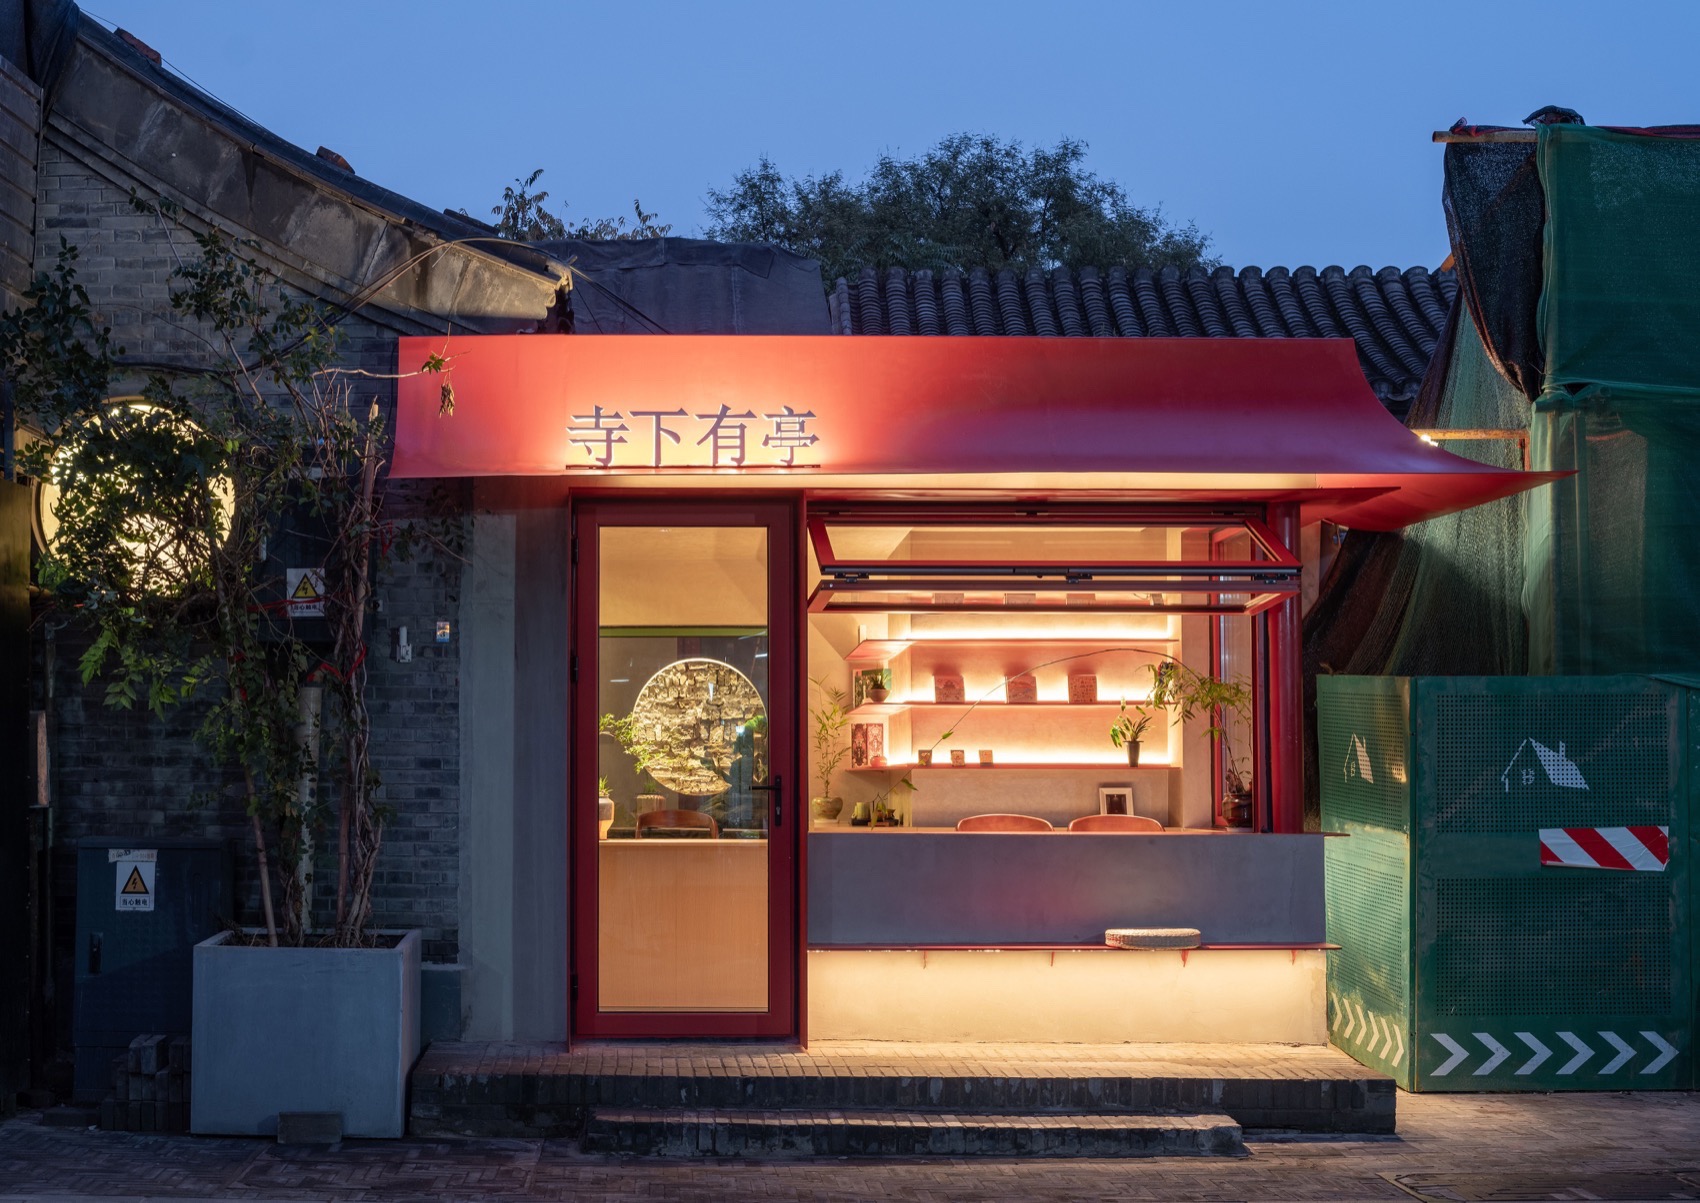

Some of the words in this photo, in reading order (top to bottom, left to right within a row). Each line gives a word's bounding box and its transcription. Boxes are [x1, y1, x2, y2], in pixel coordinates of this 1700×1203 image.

[566, 403, 820, 467] 寺下有亭
[121, 898, 148, 906] 当心触电
